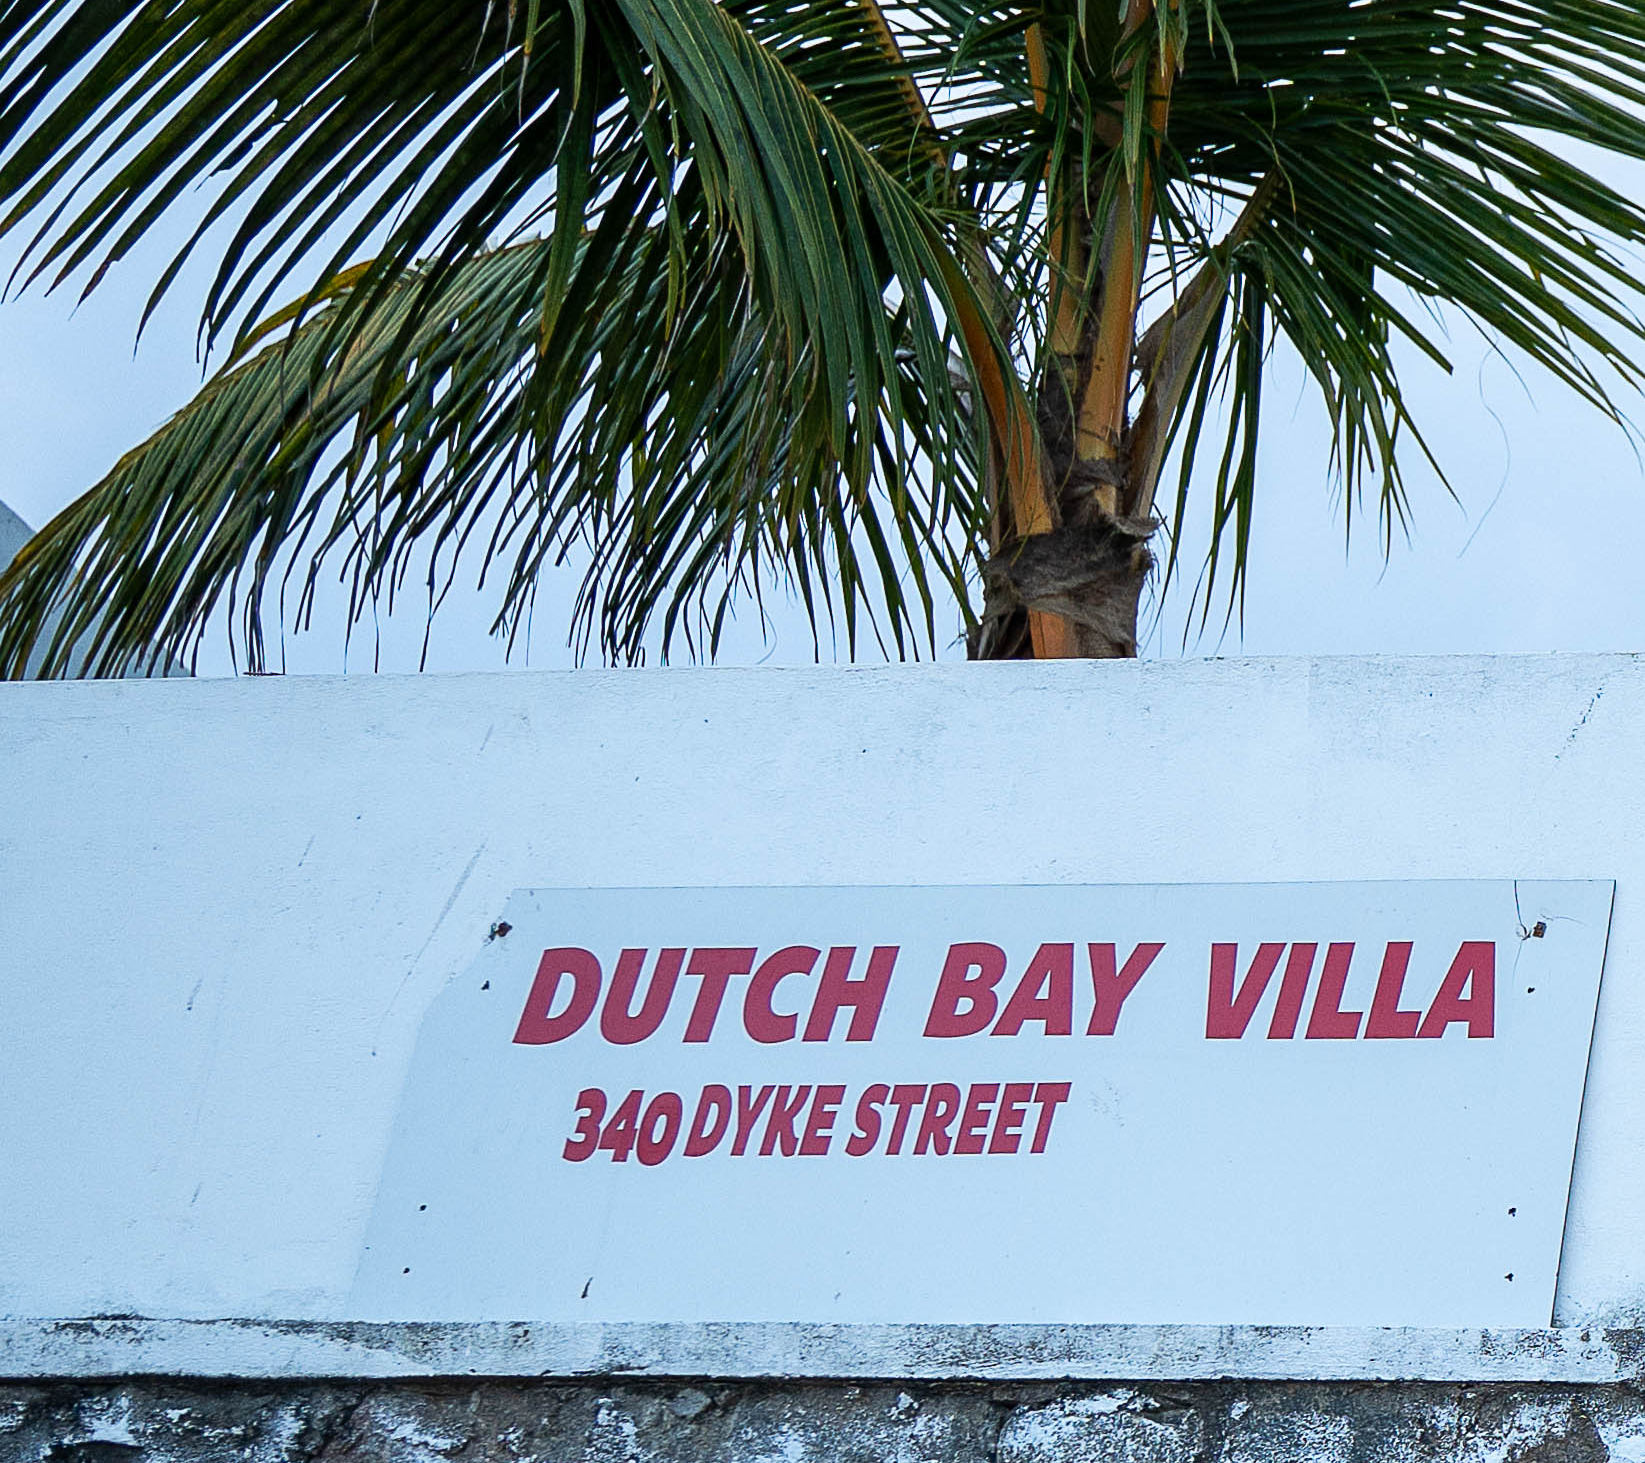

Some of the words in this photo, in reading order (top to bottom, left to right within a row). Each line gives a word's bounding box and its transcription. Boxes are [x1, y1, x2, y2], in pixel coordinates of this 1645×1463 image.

[513, 944, 899, 1045] DUTCH
[924, 942, 1165, 1038] BAY
[1205, 941, 1496, 1039] VILLA
[563, 1089, 682, 1166] 340
[684, 1084, 846, 1157] DYKE
[845, 1082, 1071, 1155] STREET
